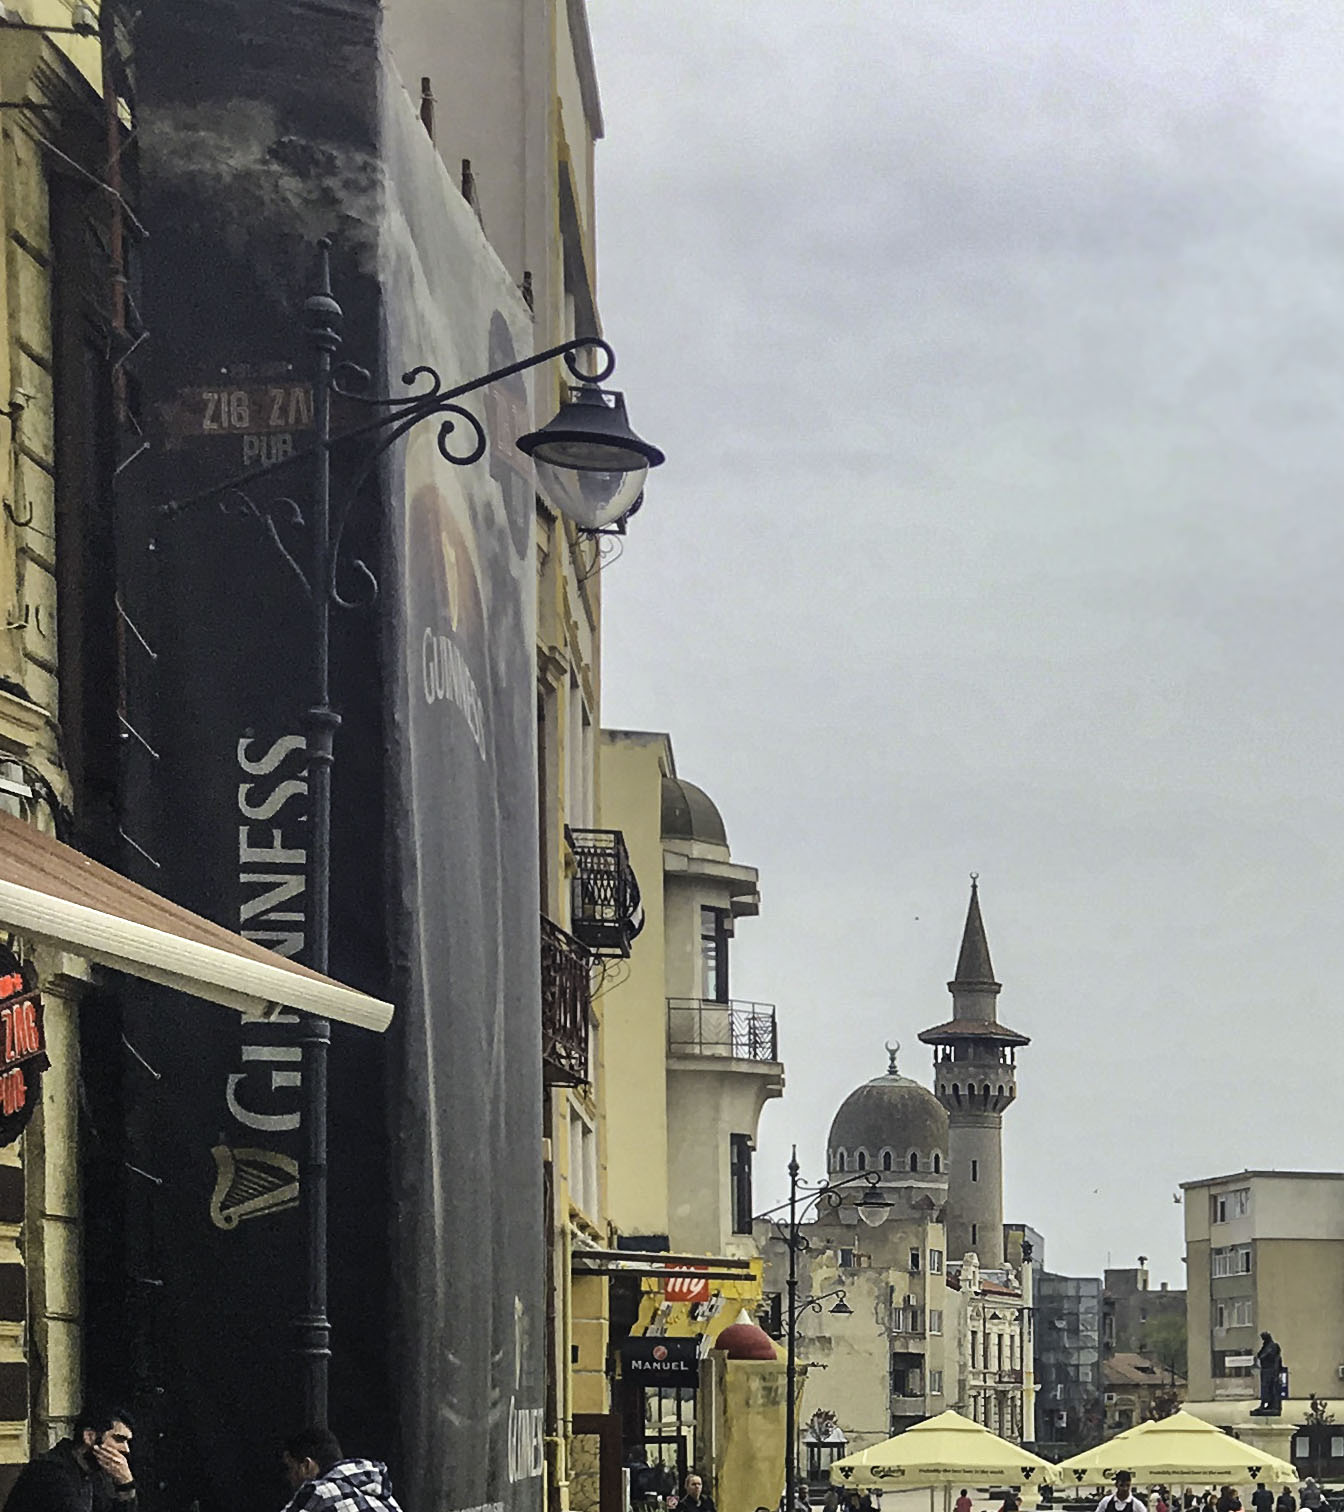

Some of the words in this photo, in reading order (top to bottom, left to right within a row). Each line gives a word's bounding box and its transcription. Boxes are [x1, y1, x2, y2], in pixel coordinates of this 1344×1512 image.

[203, 391, 250, 430] ZIG
[269, 387, 315, 426] ZA
[243, 433, 293, 468] PUB
[1, 1000, 40, 1063] ZAG
[667, 1266, 706, 1299] illy
[631, 1360, 689, 1371] MANUEL
